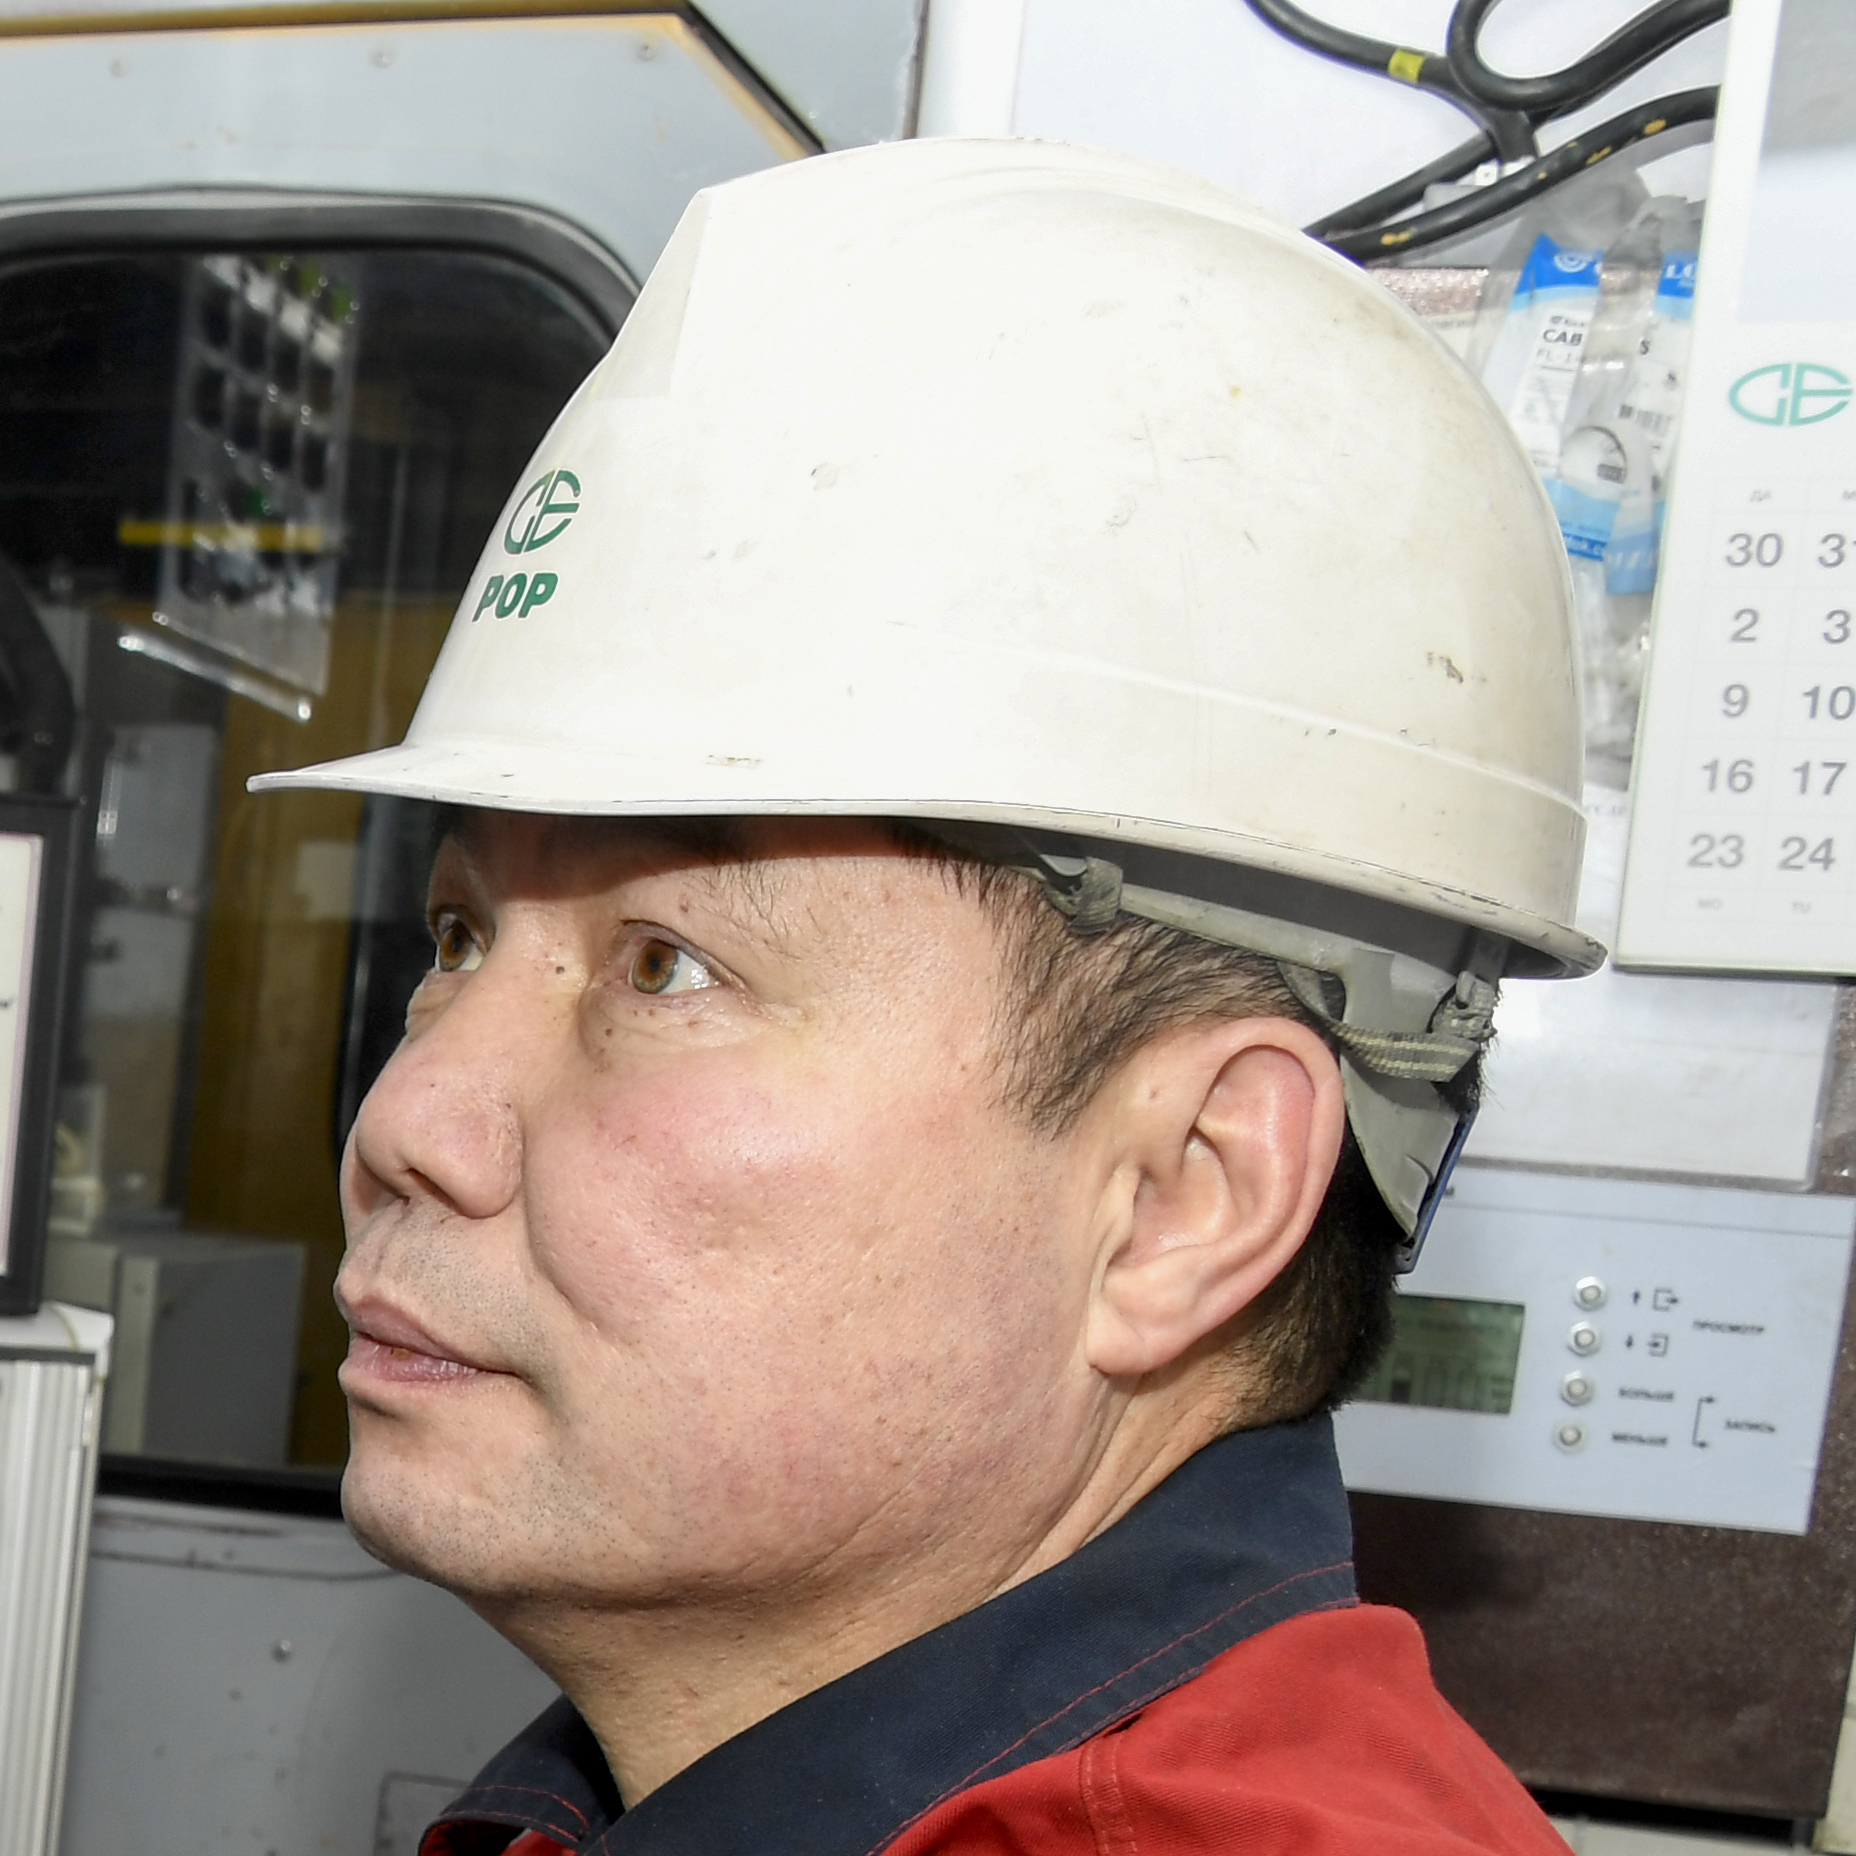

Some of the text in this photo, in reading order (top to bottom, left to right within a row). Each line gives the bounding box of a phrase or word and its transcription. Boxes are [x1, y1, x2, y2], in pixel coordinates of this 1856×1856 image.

[1725, 533, 1856, 568] 30 3
[1731, 608, 1851, 644] 2 3
[1722, 683, 1856, 720] 9 10
[1701, 759, 1847, 796] 16 17
[1688, 833, 1836, 872] 23 24
